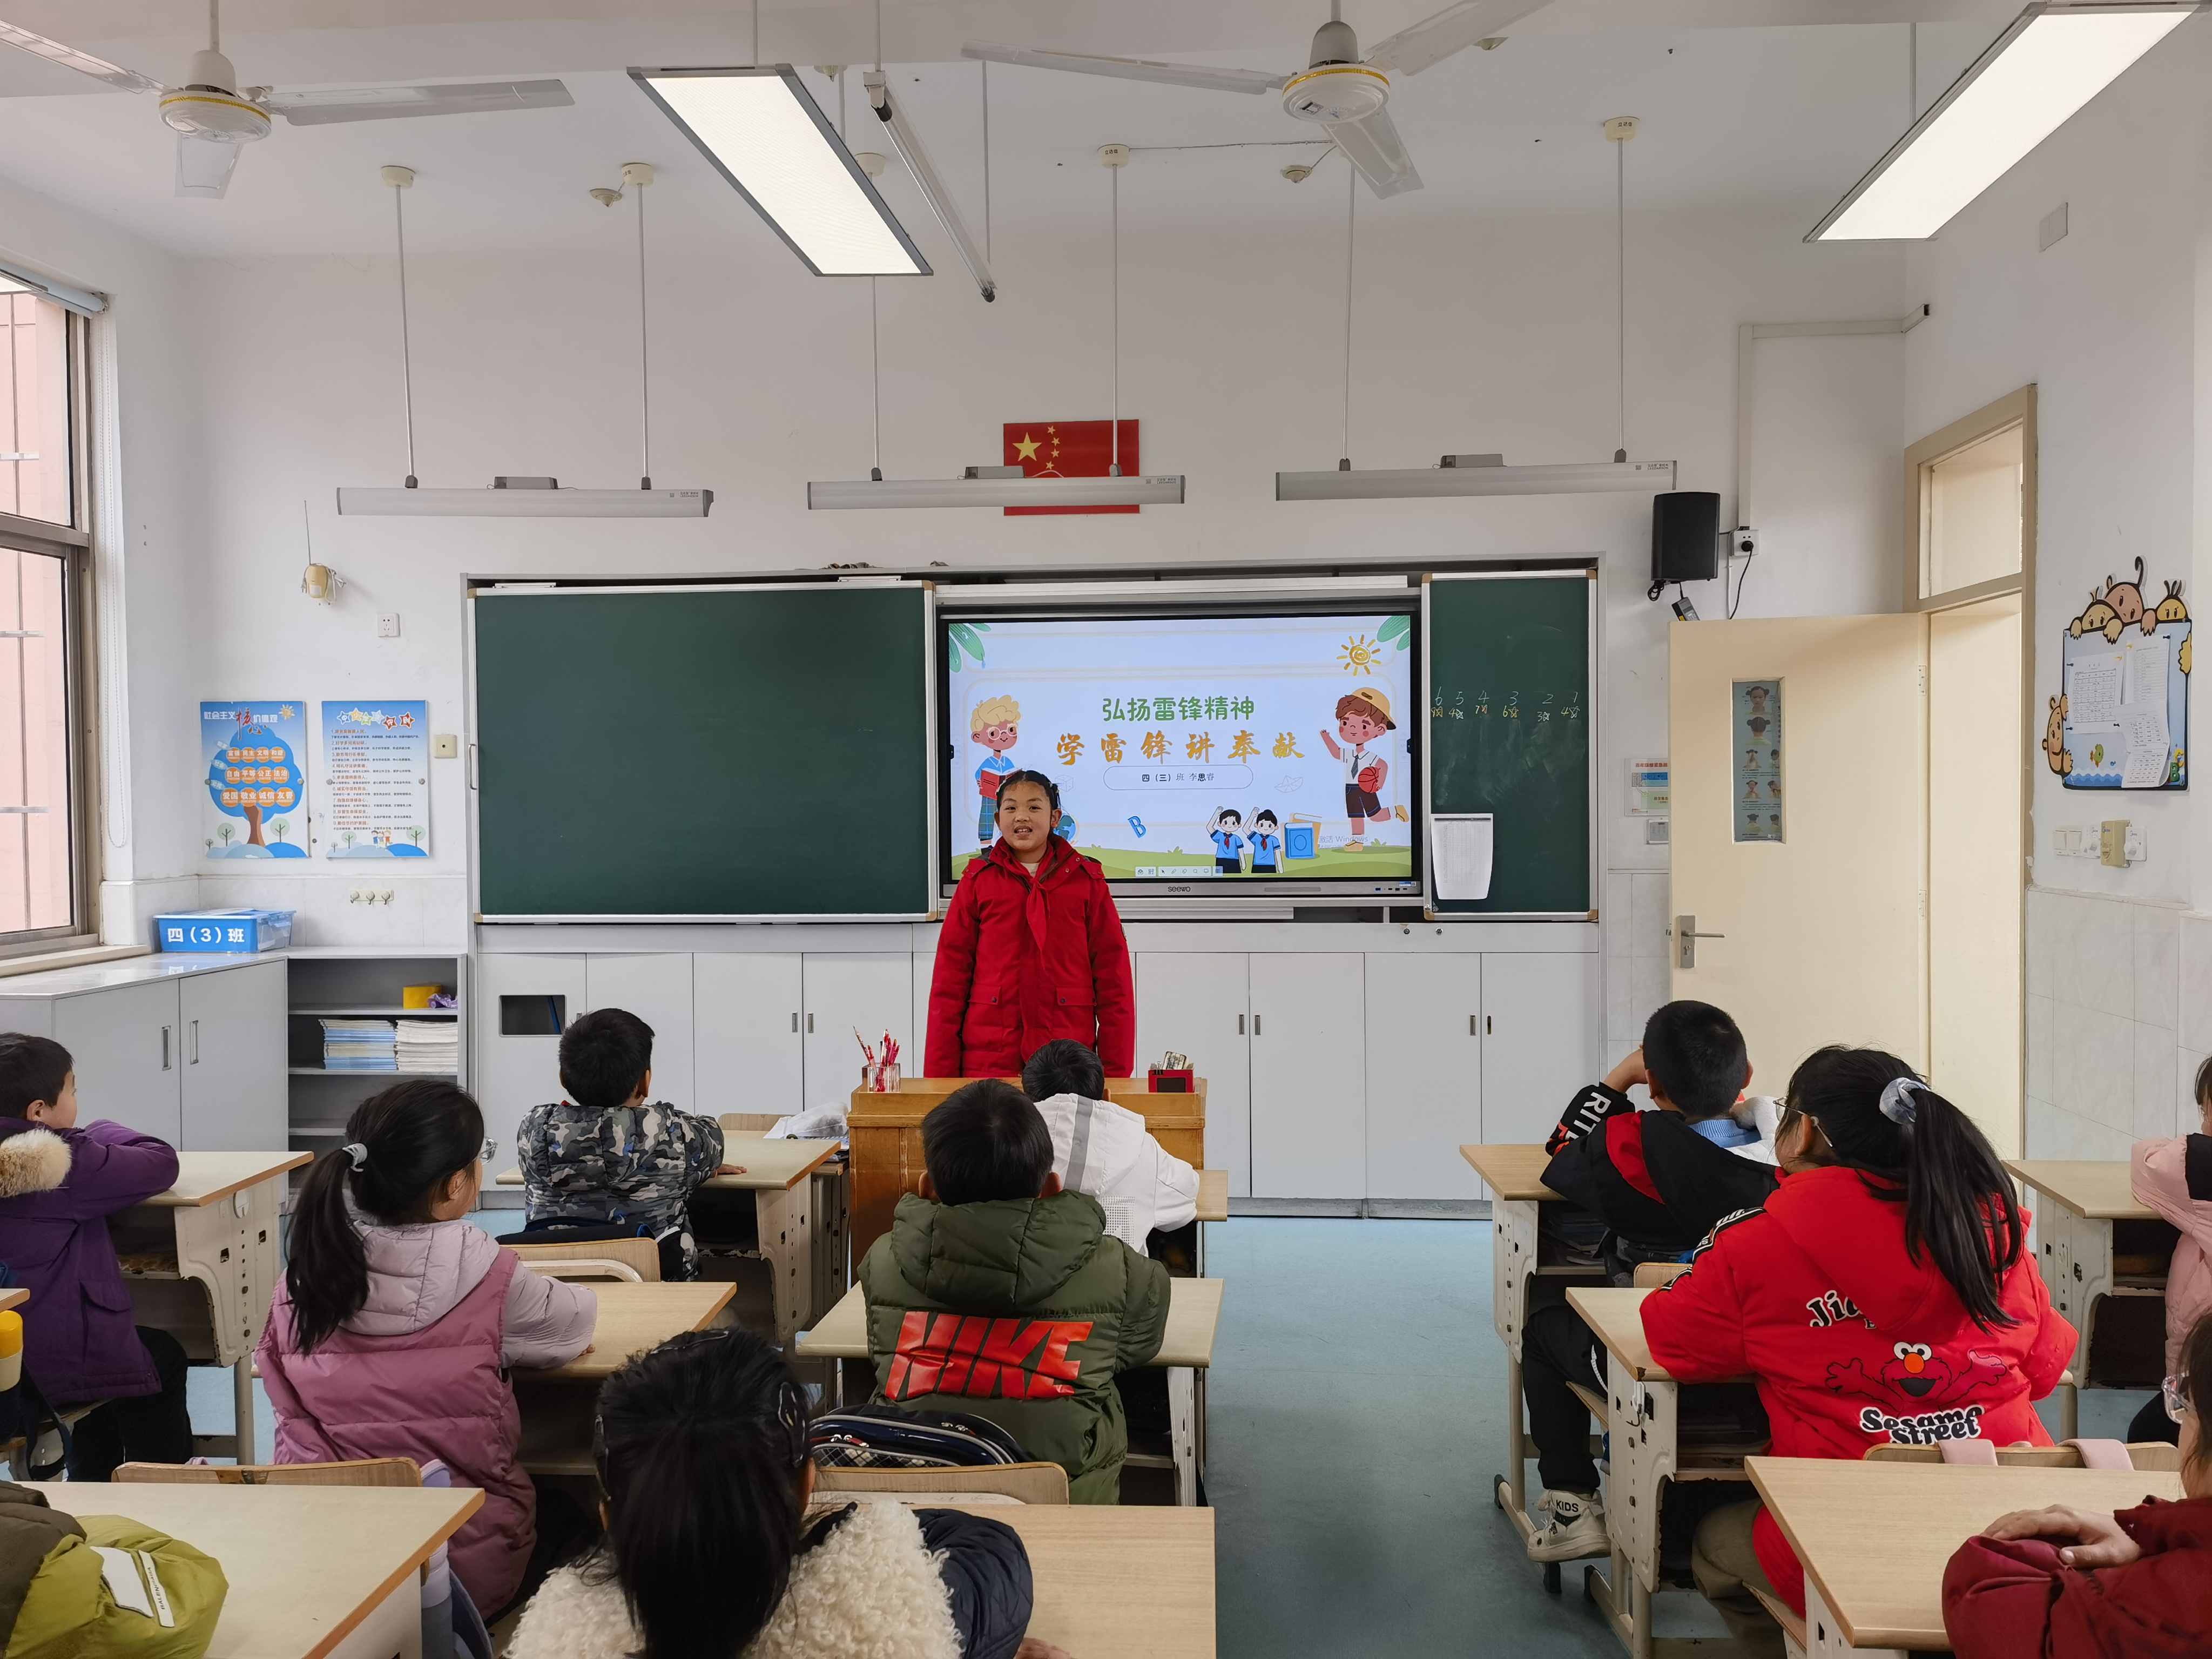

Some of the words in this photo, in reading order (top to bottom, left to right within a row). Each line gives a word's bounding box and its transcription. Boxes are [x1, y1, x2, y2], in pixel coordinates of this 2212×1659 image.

[1435, 686, 1442, 706] 6
[1455, 692, 1464, 705] 5
[1478, 690, 1490, 703] 4
[1509, 691, 1519, 705] 3
[1542, 694, 1554, 704] 2
[1102, 696, 1255, 721] 弘扬雷锋精神
[1189, 772, 1215, 782] 李思睿
[240, 792, 257, 800] 敬业
[1319, 835, 1334, 844] 激活
[885, 1311, 1094, 1401] NIKE
[1859, 1404, 1986, 1433] Sesame
[1889, 1419, 1982, 1445] Street
[1555, 1499, 1579, 1513] KIDS
